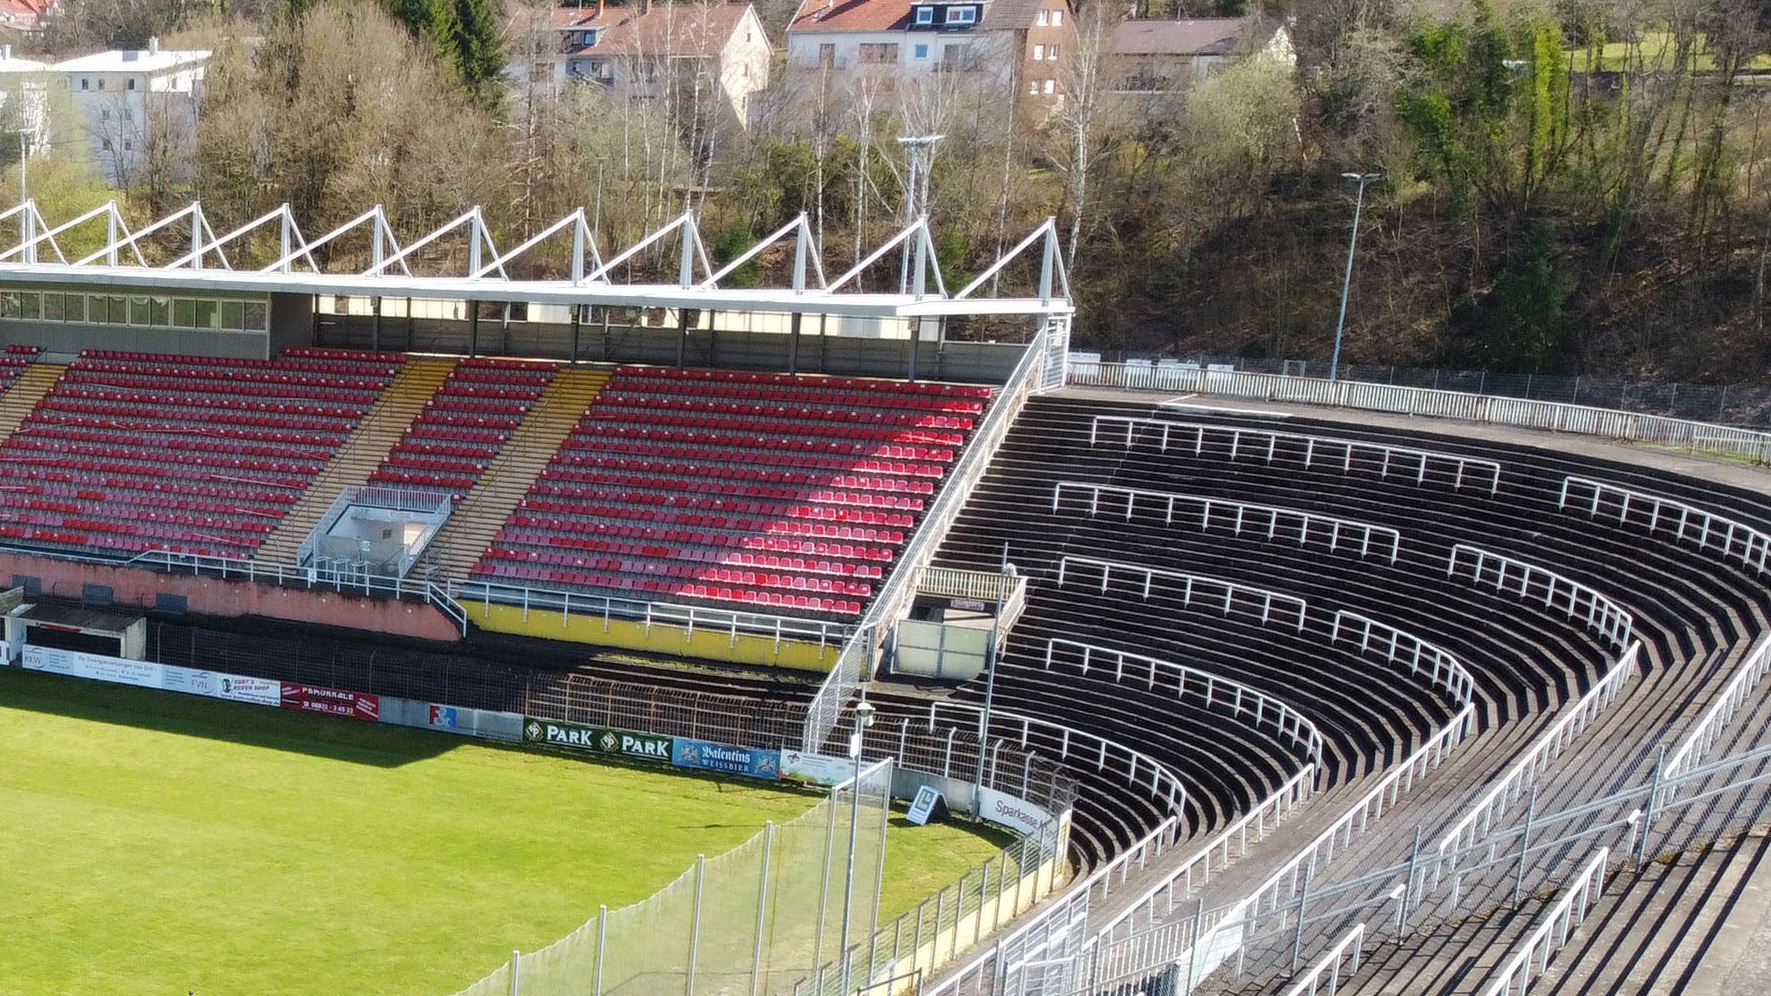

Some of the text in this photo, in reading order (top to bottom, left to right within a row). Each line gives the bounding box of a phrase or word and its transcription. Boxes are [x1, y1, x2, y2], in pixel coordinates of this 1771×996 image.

[546, 724, 593, 746] PARK
[622, 735, 670, 757] PARK
[702, 746, 751, 764] Valentins
[702, 758, 750, 773] WEISSBIER
[995, 800, 1038, 828] Sparkasse
